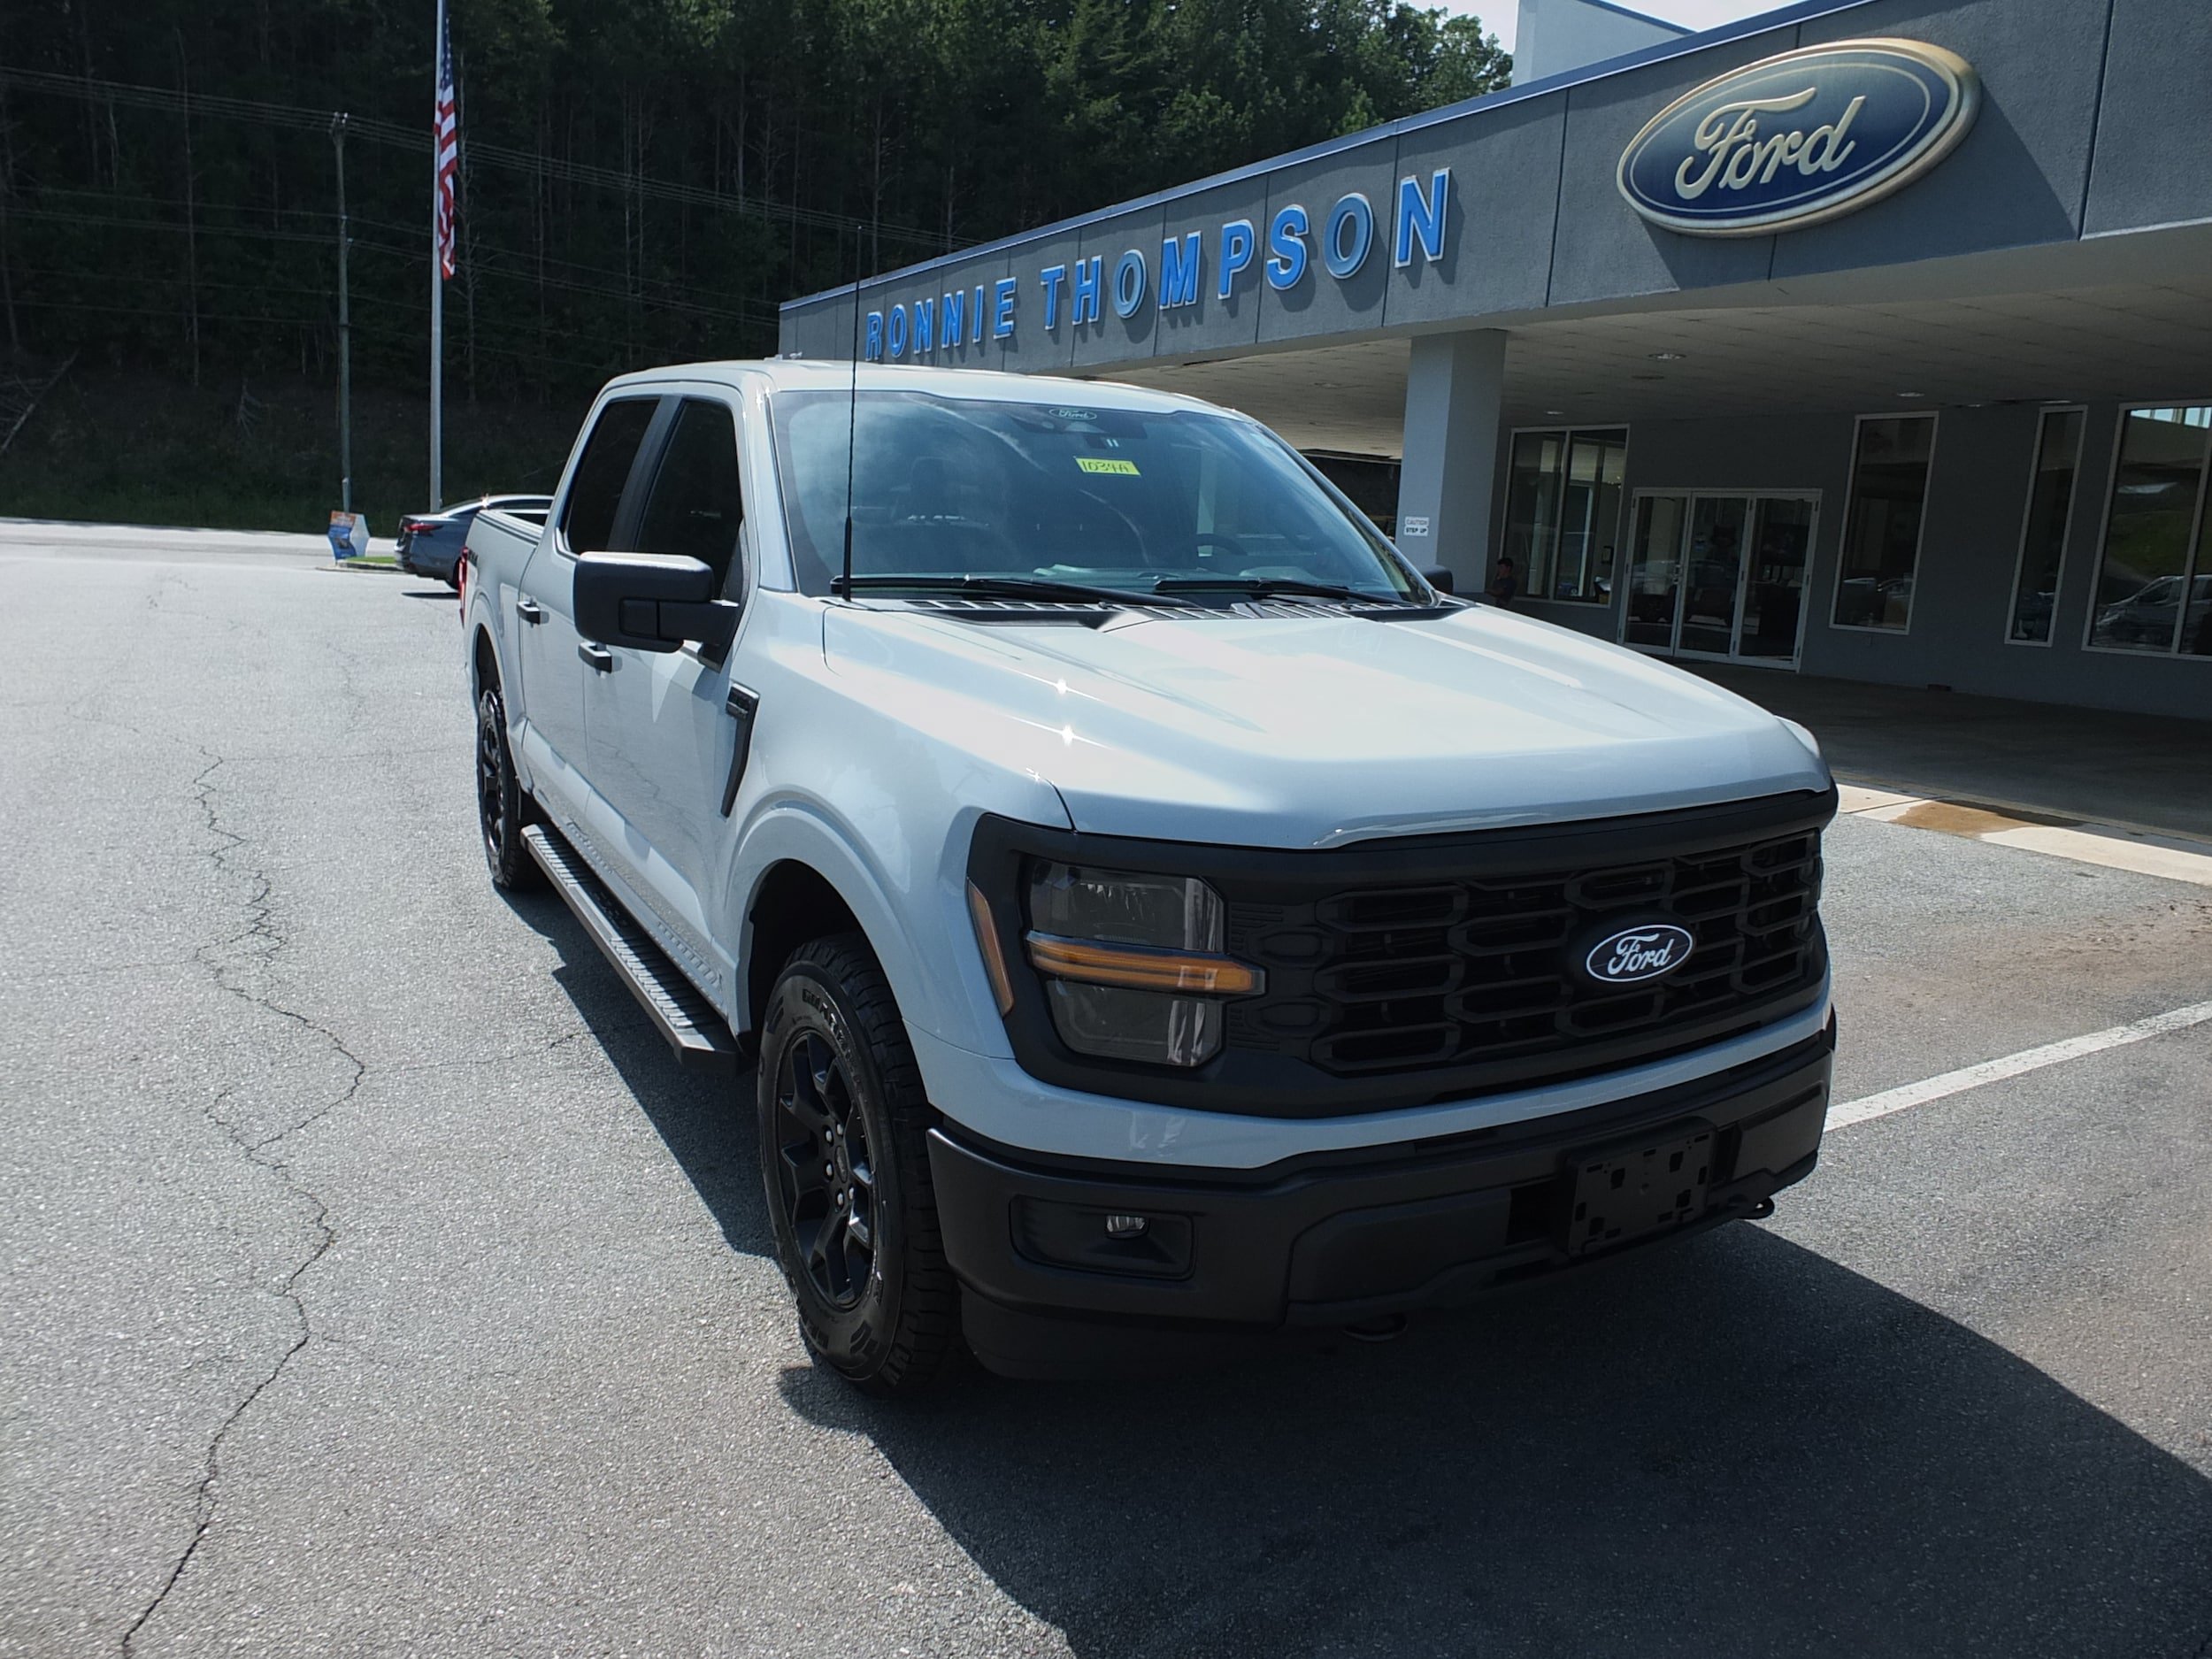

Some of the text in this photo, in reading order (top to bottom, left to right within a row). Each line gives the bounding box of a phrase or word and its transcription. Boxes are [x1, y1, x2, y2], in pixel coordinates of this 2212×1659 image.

[1674, 87, 1866, 200] Ford
[864, 166, 1452, 361] RONNIE THOMPSON
[1607, 933, 1675, 975] Ford
